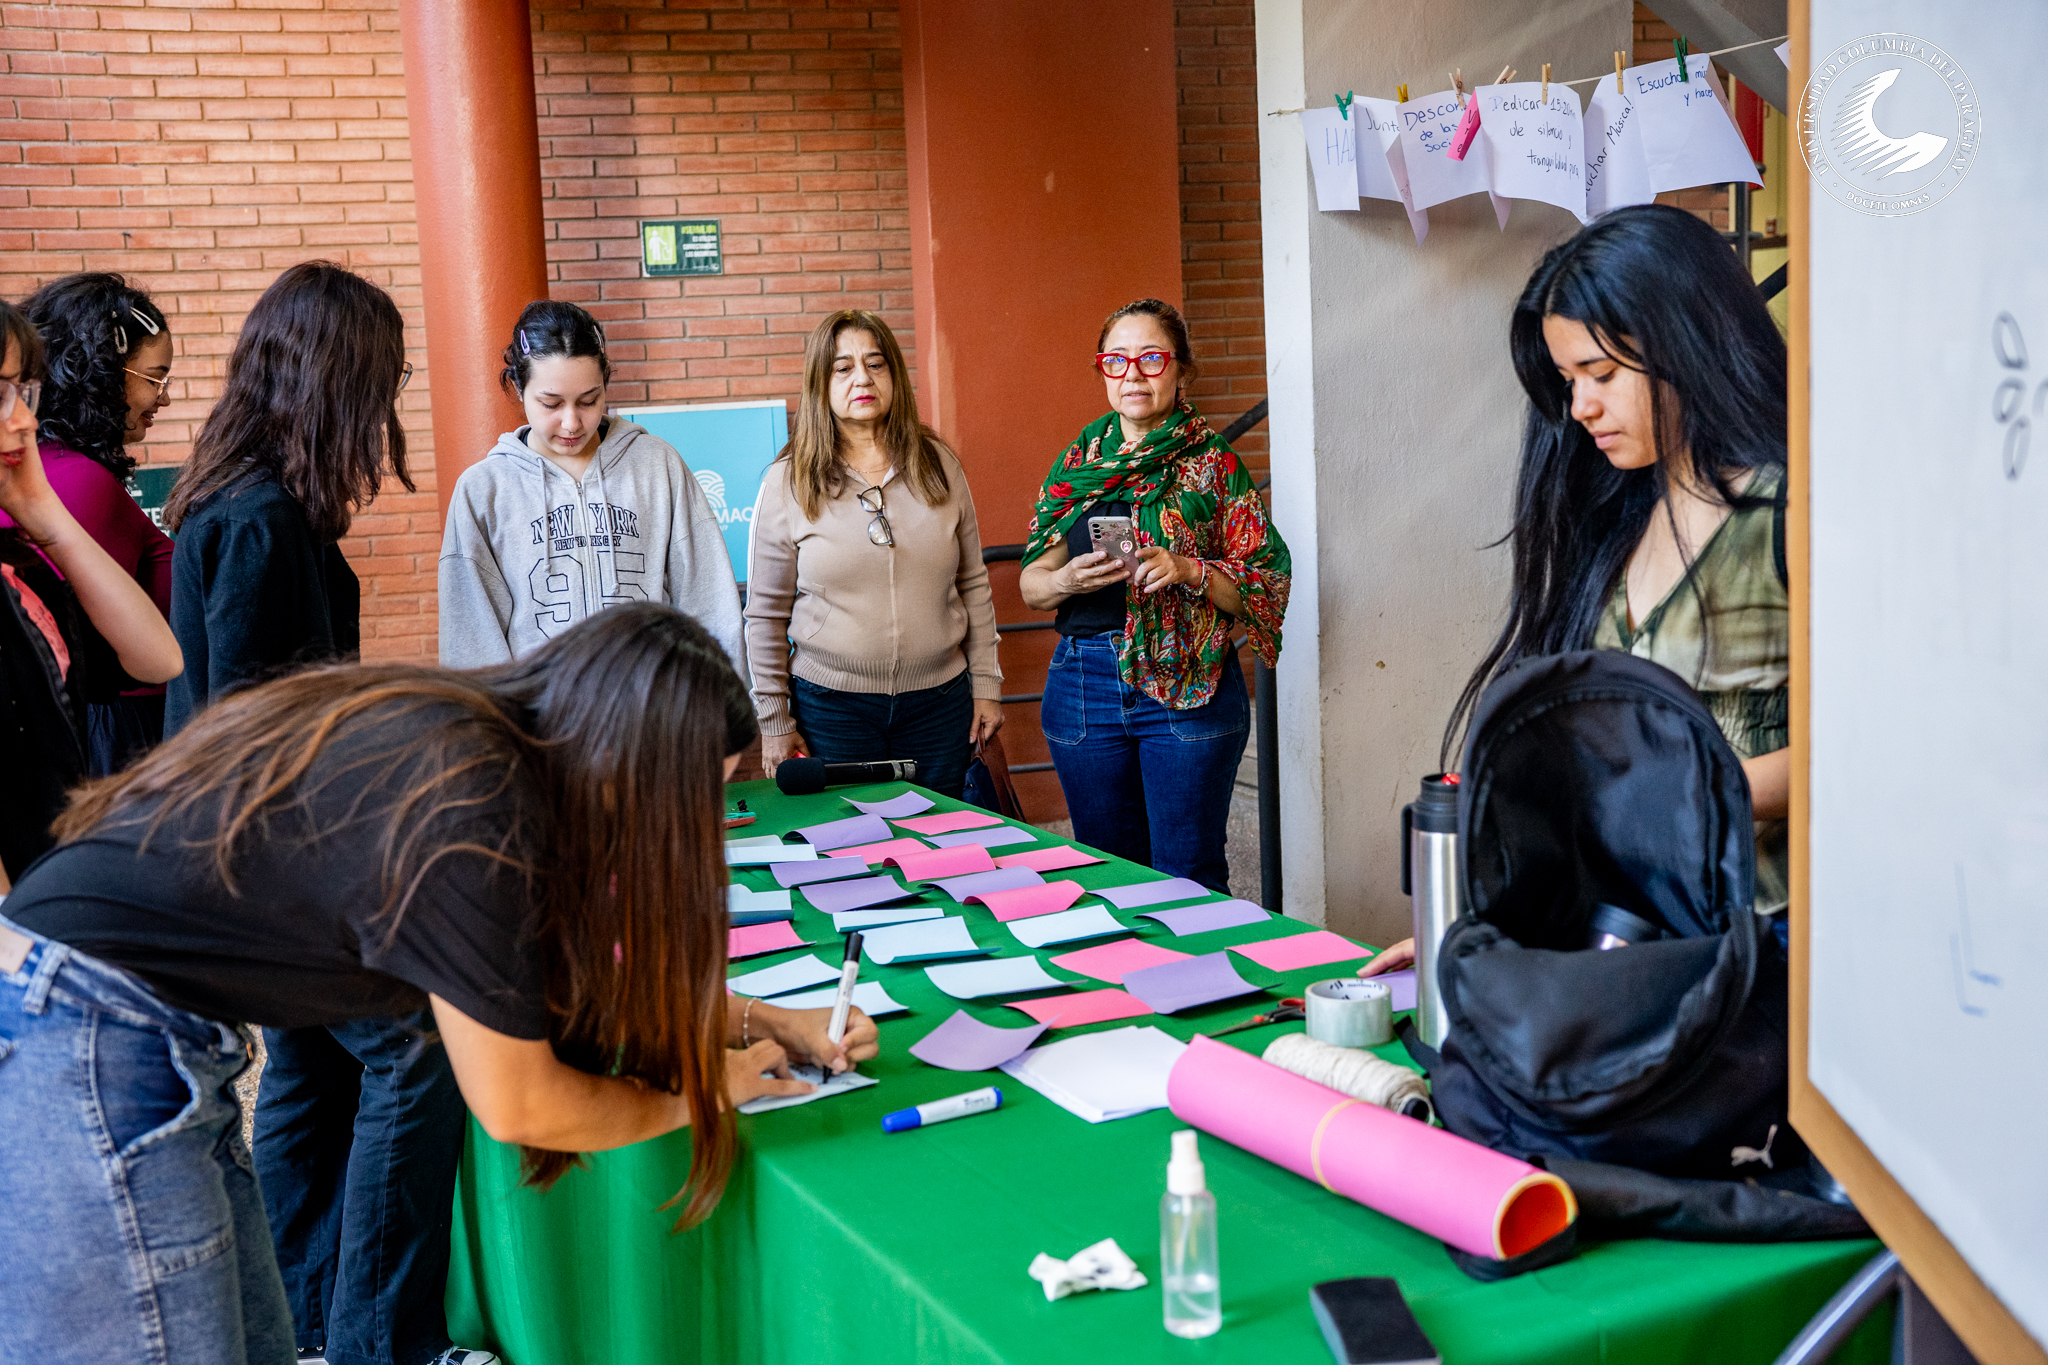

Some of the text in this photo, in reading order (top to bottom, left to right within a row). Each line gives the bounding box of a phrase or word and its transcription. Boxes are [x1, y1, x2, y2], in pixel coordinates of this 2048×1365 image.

[1419, 130, 1434, 142] de
[1424, 138, 1452, 153] soci
[530, 504, 575, 545] NEW
[554, 536, 575, 552] NEW
